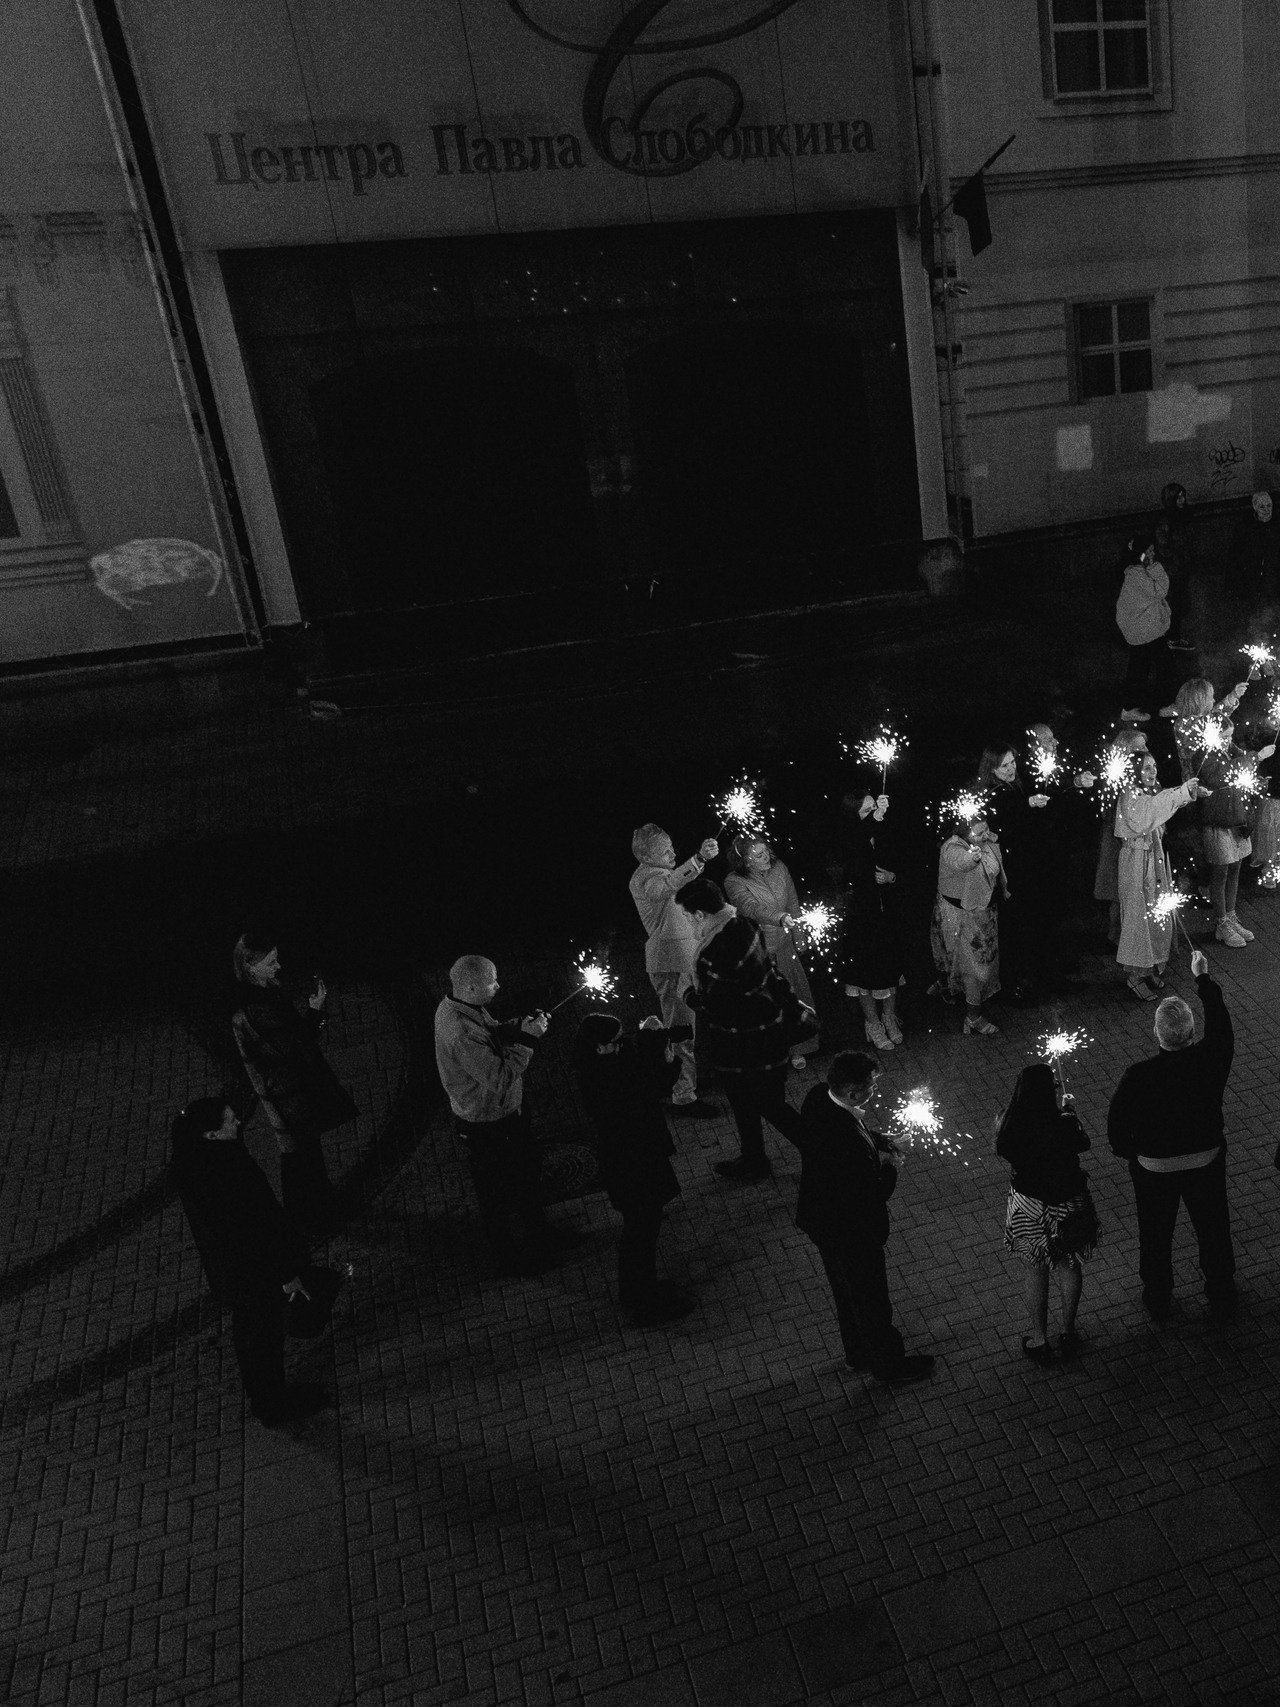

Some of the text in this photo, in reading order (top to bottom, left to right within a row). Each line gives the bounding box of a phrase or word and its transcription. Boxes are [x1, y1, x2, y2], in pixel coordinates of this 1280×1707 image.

[203, 111, 877, 197] Центра Павла Слободкина
